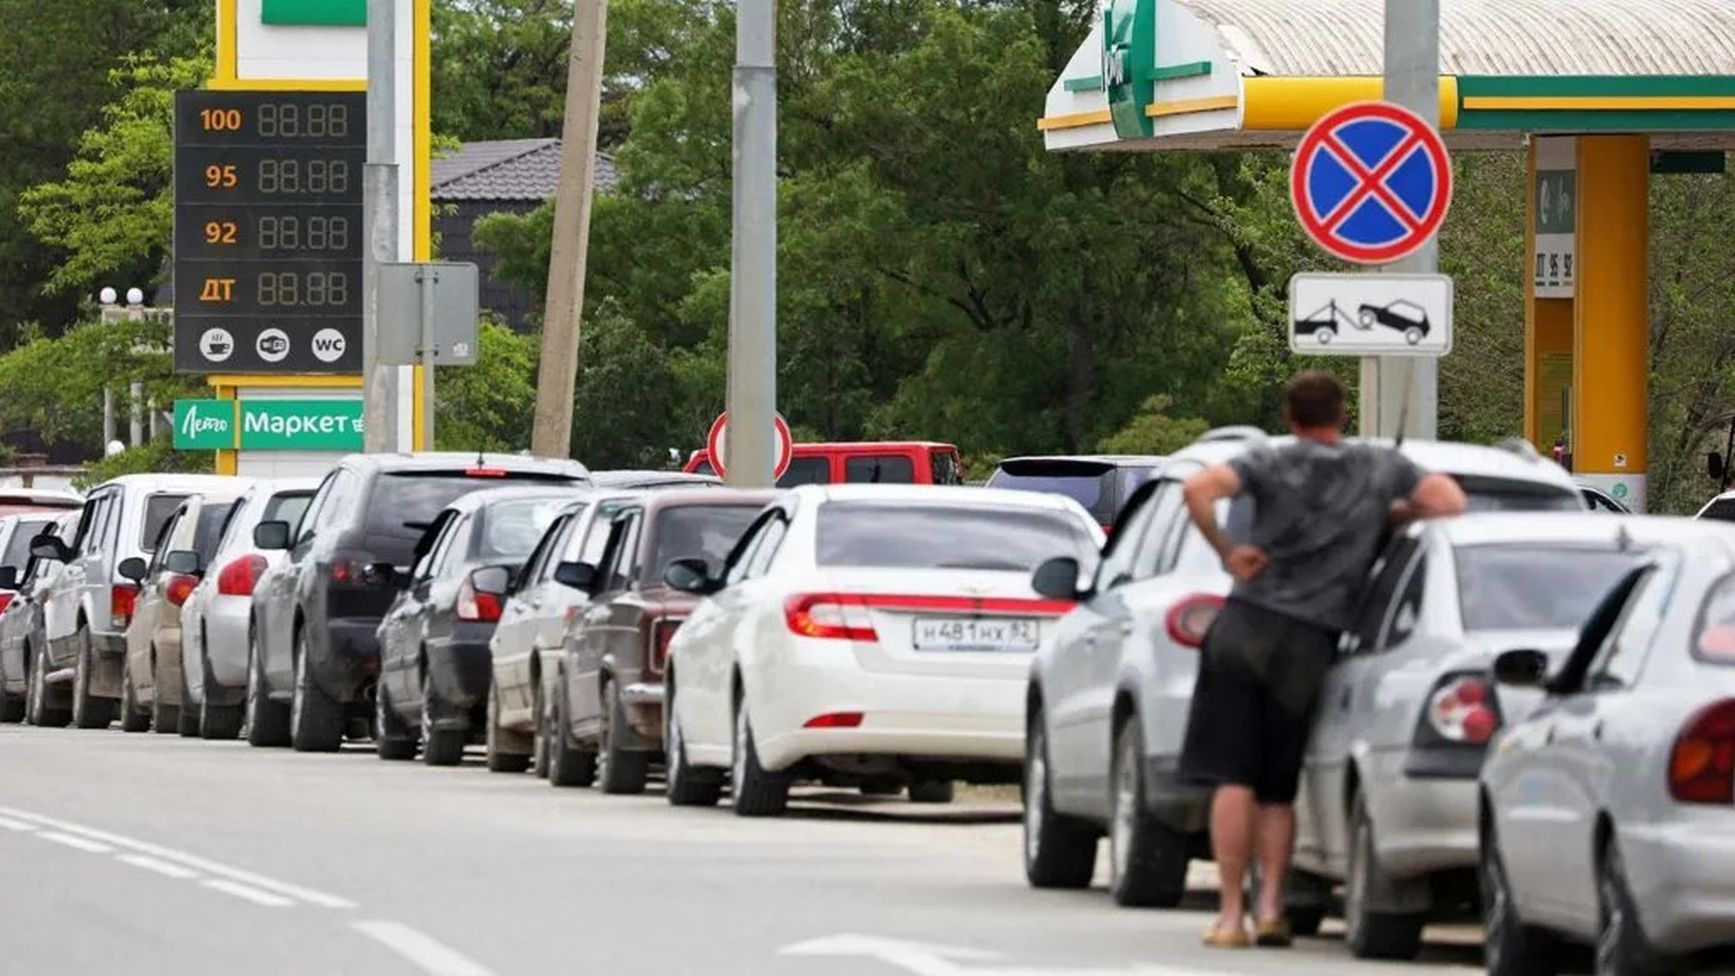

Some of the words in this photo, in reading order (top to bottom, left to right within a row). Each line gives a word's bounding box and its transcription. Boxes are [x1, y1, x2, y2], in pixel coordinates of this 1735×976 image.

[201, 108, 242, 131] 100
[205, 164, 238, 188] 95
[205, 221, 237, 244] 92
[199, 278, 236, 301] ДТ
[315, 338, 343, 352] WC
[182, 405, 228, 439] Лето
[244, 412, 348, 437] Маркет
